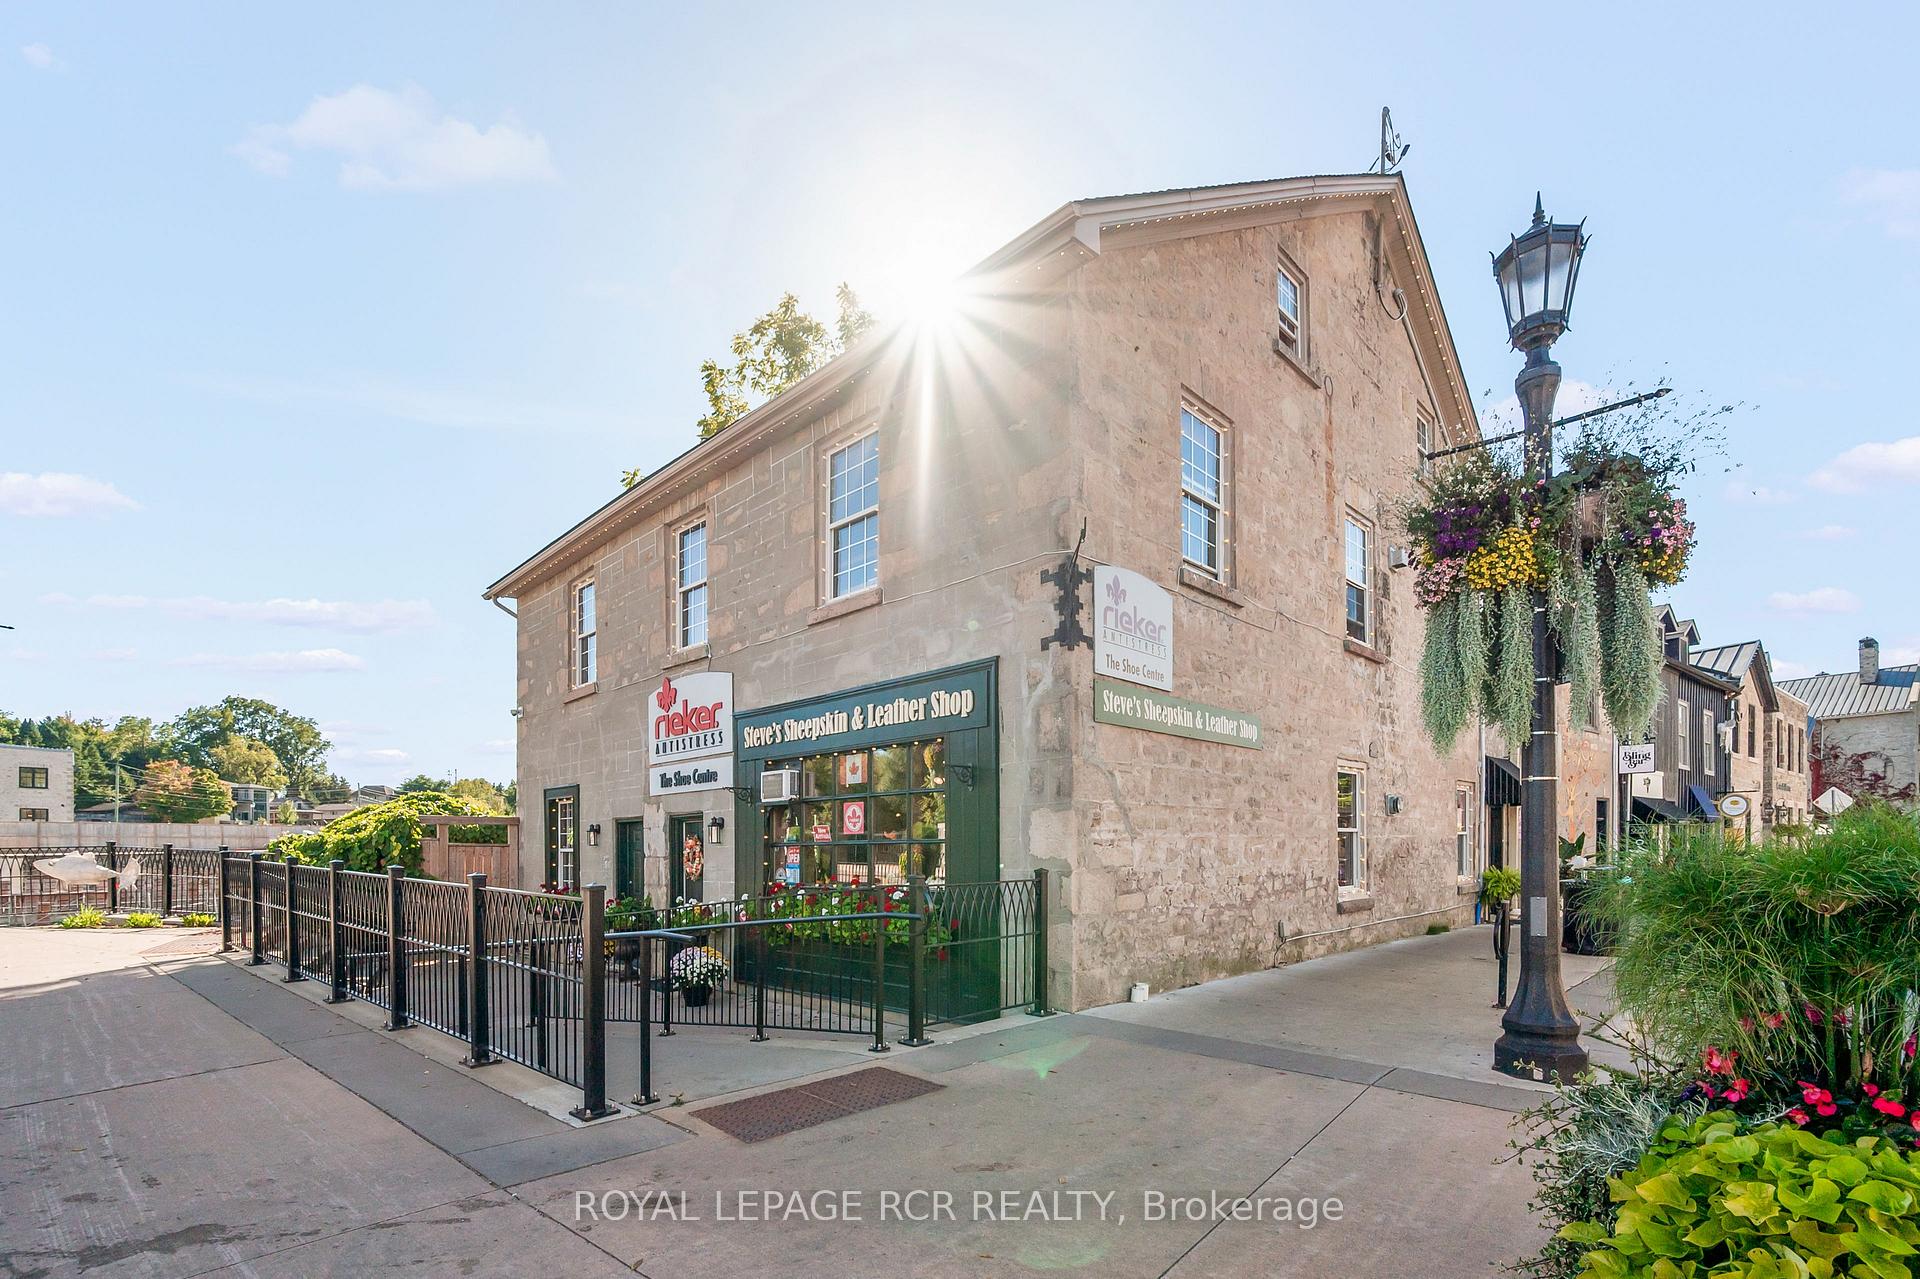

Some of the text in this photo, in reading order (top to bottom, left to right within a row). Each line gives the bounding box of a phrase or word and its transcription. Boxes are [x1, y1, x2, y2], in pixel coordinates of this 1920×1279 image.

[1103, 605, 1167, 642] rieker
[1103, 629, 1167, 658] ANTISTRESS
[1106, 653, 1165, 682] The Shoe Centre
[655, 699, 723, 739] rieker
[743, 689, 974, 749] Steve's Sheepskin & Leather Shop
[1103, 689, 1258, 742] Steve's Sheepskin & Leather Shop
[656, 731, 723, 755] ANTISTRESS
[1623, 751, 1652, 761] Bling
[660, 769, 718, 788] The Shoe Centre
